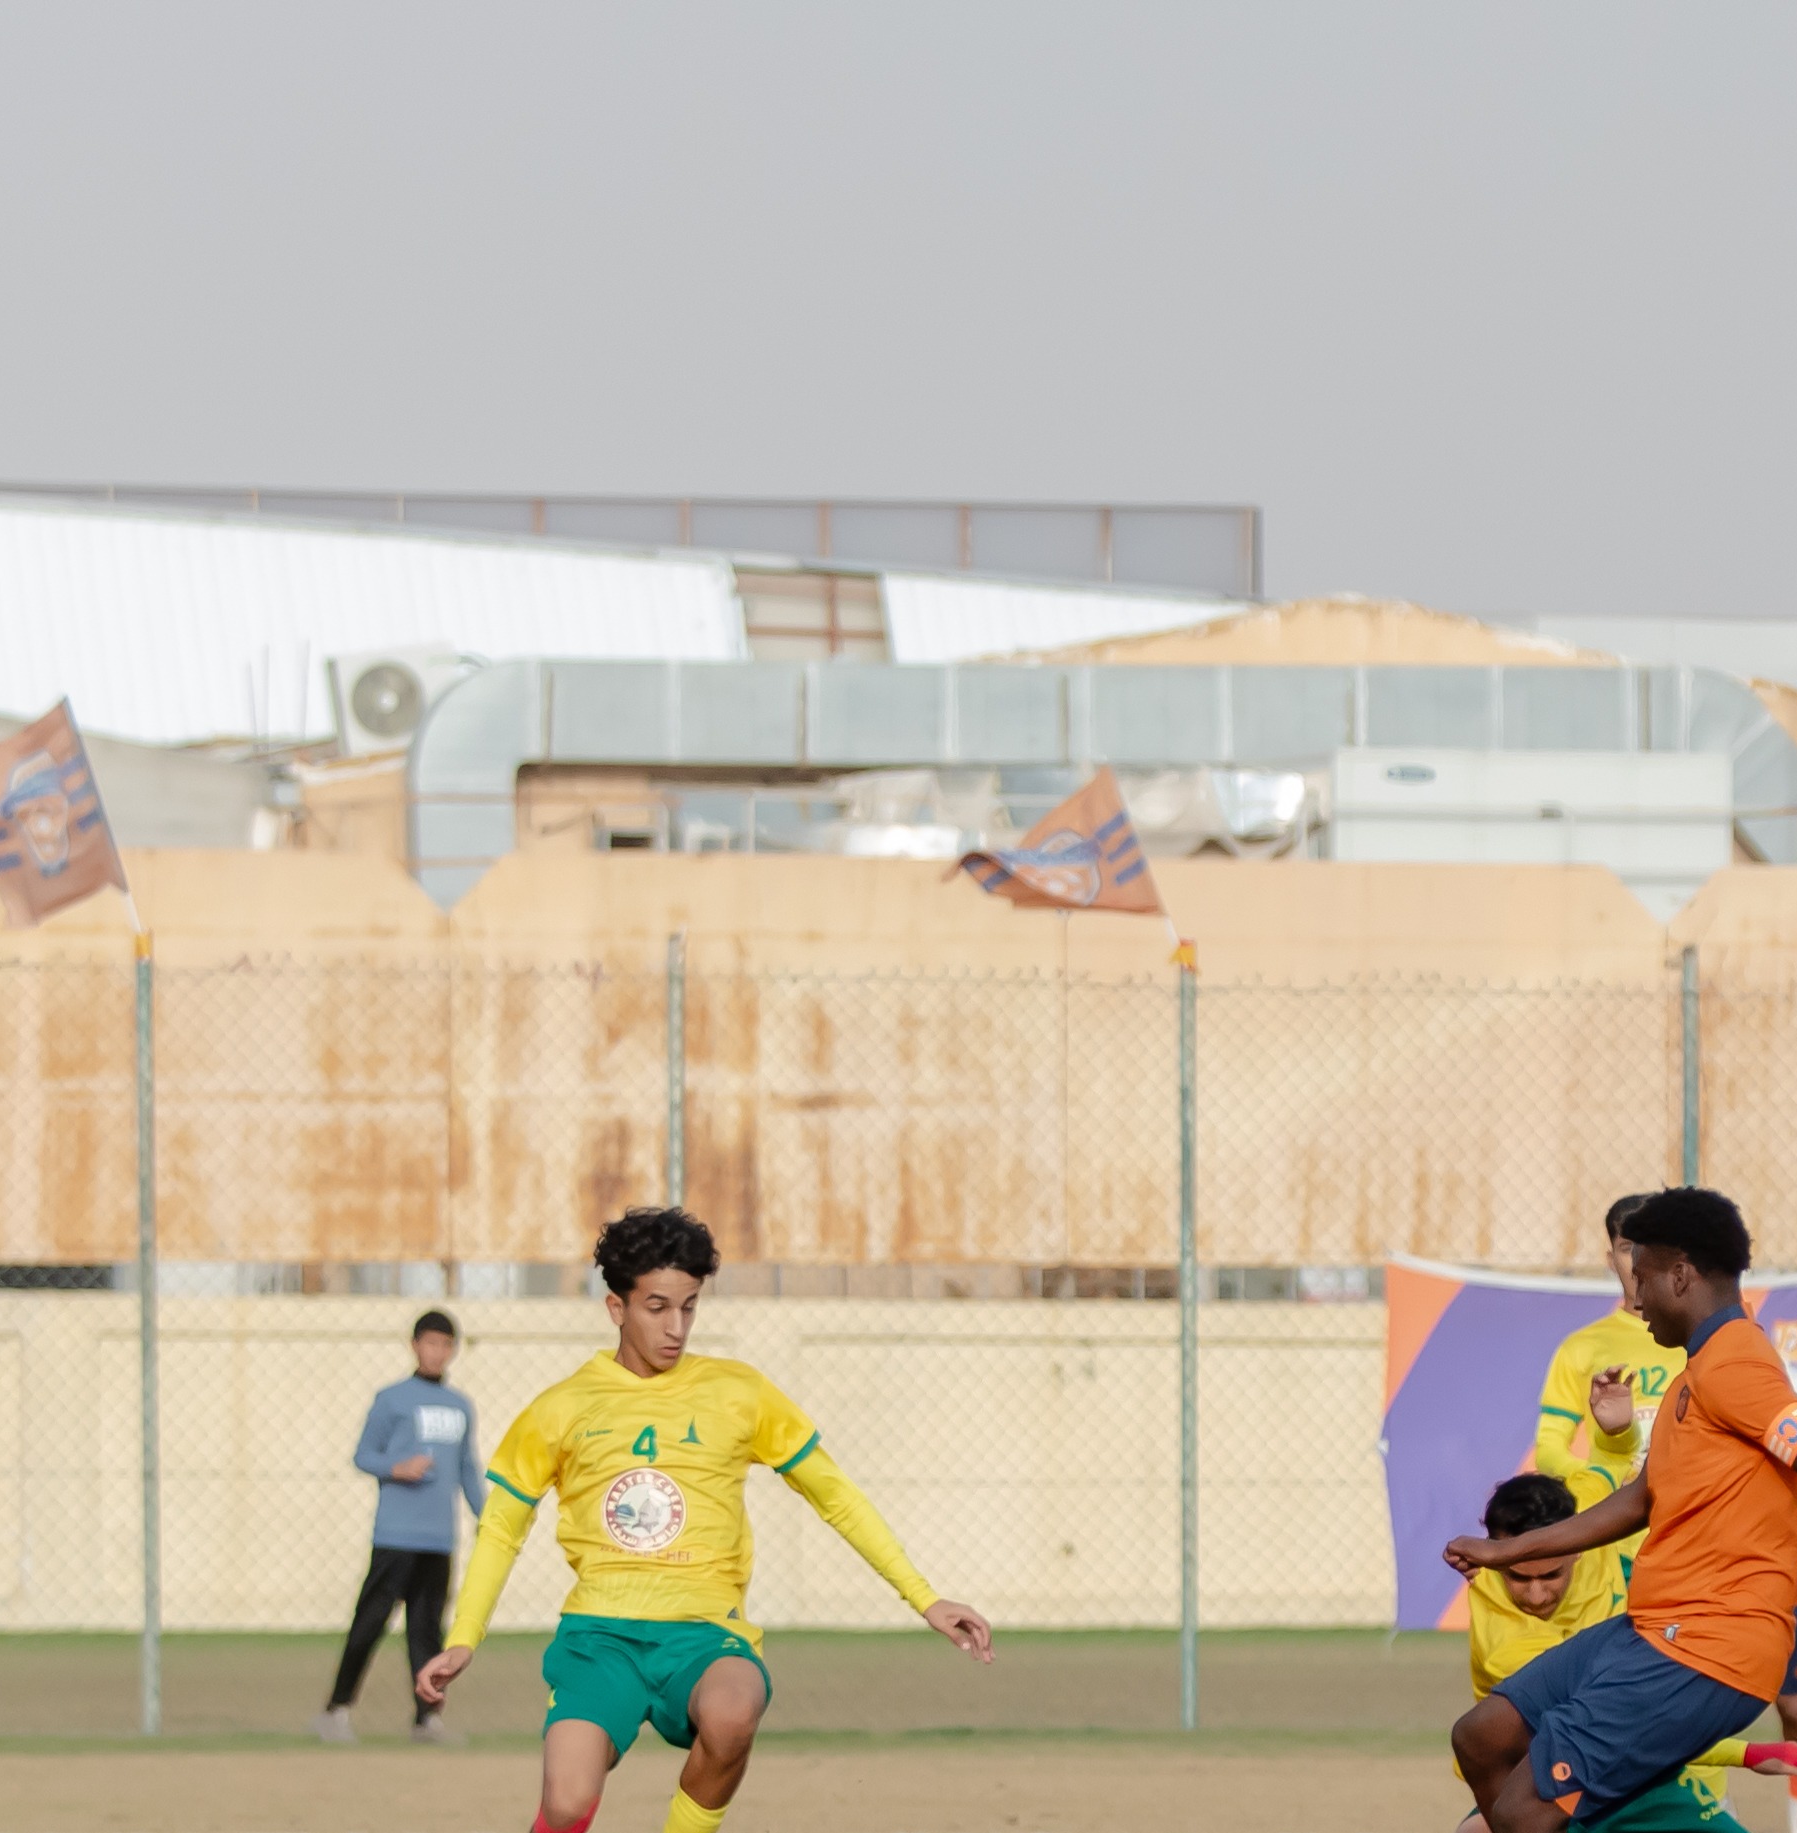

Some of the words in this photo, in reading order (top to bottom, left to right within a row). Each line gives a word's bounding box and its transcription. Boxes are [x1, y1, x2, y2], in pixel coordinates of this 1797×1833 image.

[1639, 1365, 1667, 1397] 12
[631, 1424, 658, 1463] 4
[607, 1473, 654, 1510] MASTER
[656, 1478, 682, 1511] CHEF
